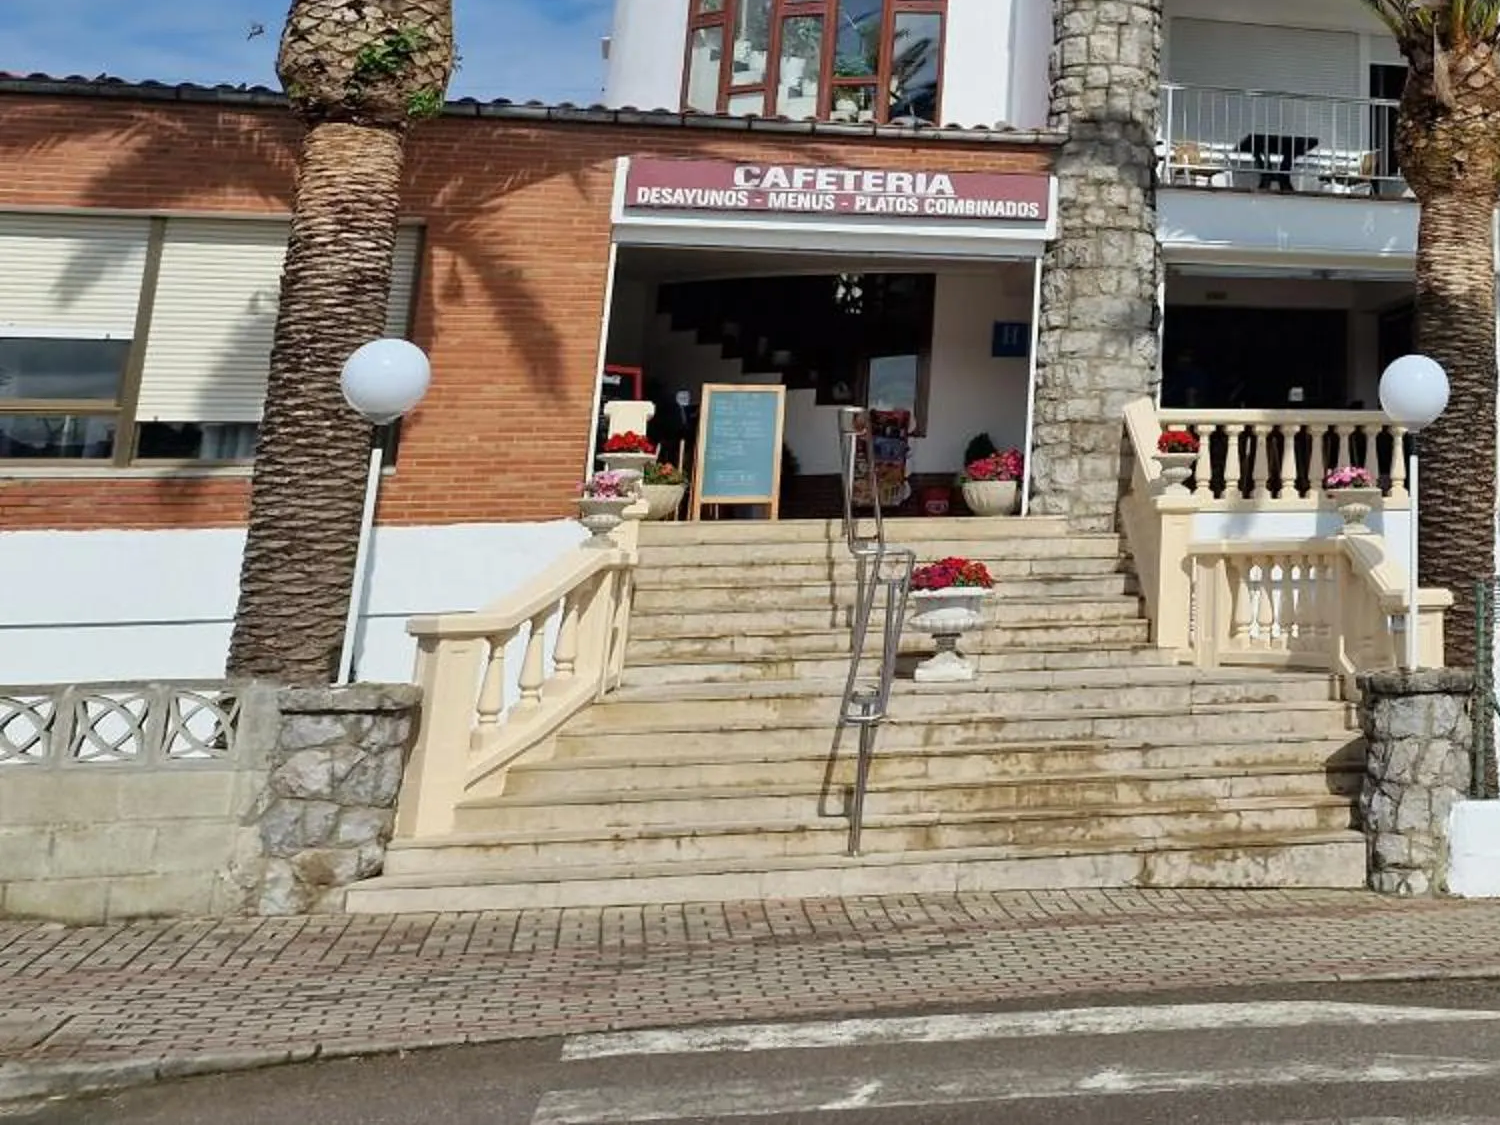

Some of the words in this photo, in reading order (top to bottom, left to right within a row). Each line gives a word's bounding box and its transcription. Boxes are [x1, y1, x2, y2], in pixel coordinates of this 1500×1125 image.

[733, 165, 955, 196] CAFETERIA
[636, 187, 748, 207] DESAYUNOS
[768, 194, 835, 210] MENUS
[855, 196, 918, 213] PLATOS
[924, 198, 1039, 218] COMBINADOS
